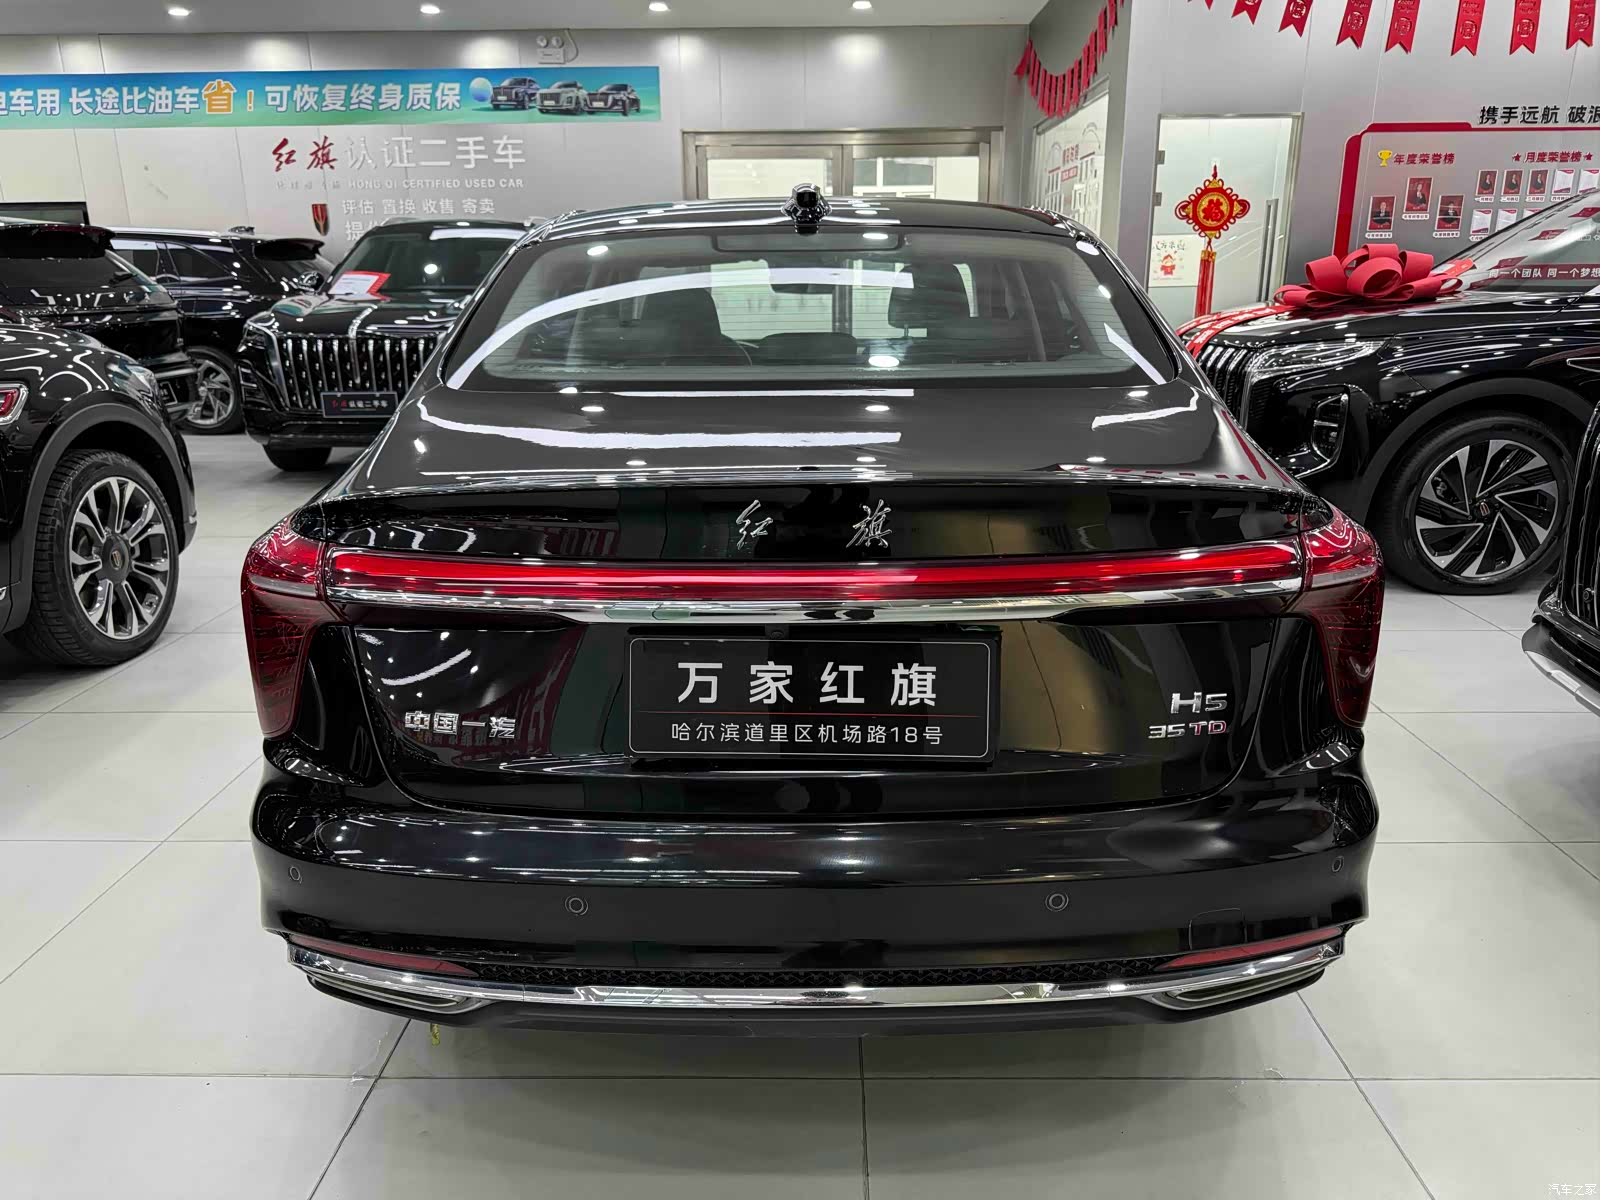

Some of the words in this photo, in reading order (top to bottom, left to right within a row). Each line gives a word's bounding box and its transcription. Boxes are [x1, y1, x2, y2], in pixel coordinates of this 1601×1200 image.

[1479, 105, 1560, 125] 携手远航
[1394, 152, 1455, 165] 年度荣誉榜
[1525, 151, 1582, 163] 月度荣誉榜
[348, 179, 381, 189] HONG
[403, 179, 460, 188] CERTIFIED
[465, 179, 496, 188] USED
[499, 179, 524, 188] CAR
[342, 199, 374, 215] 评估
[382, 199, 416, 215] 置换
[422, 198, 454, 215] 收售
[462, 198, 496, 214] 寄卖
[1202, 199, 1225, 222] 福
[1547, 268, 1600, 278] 同一个梦想
[677, 661, 937, 707] 万家红旗
[1171, 692, 1227, 714] H5
[405, 710, 516, 739] 中国一汽
[671, 722, 944, 745] 哈尔滨道里区机场路18号
